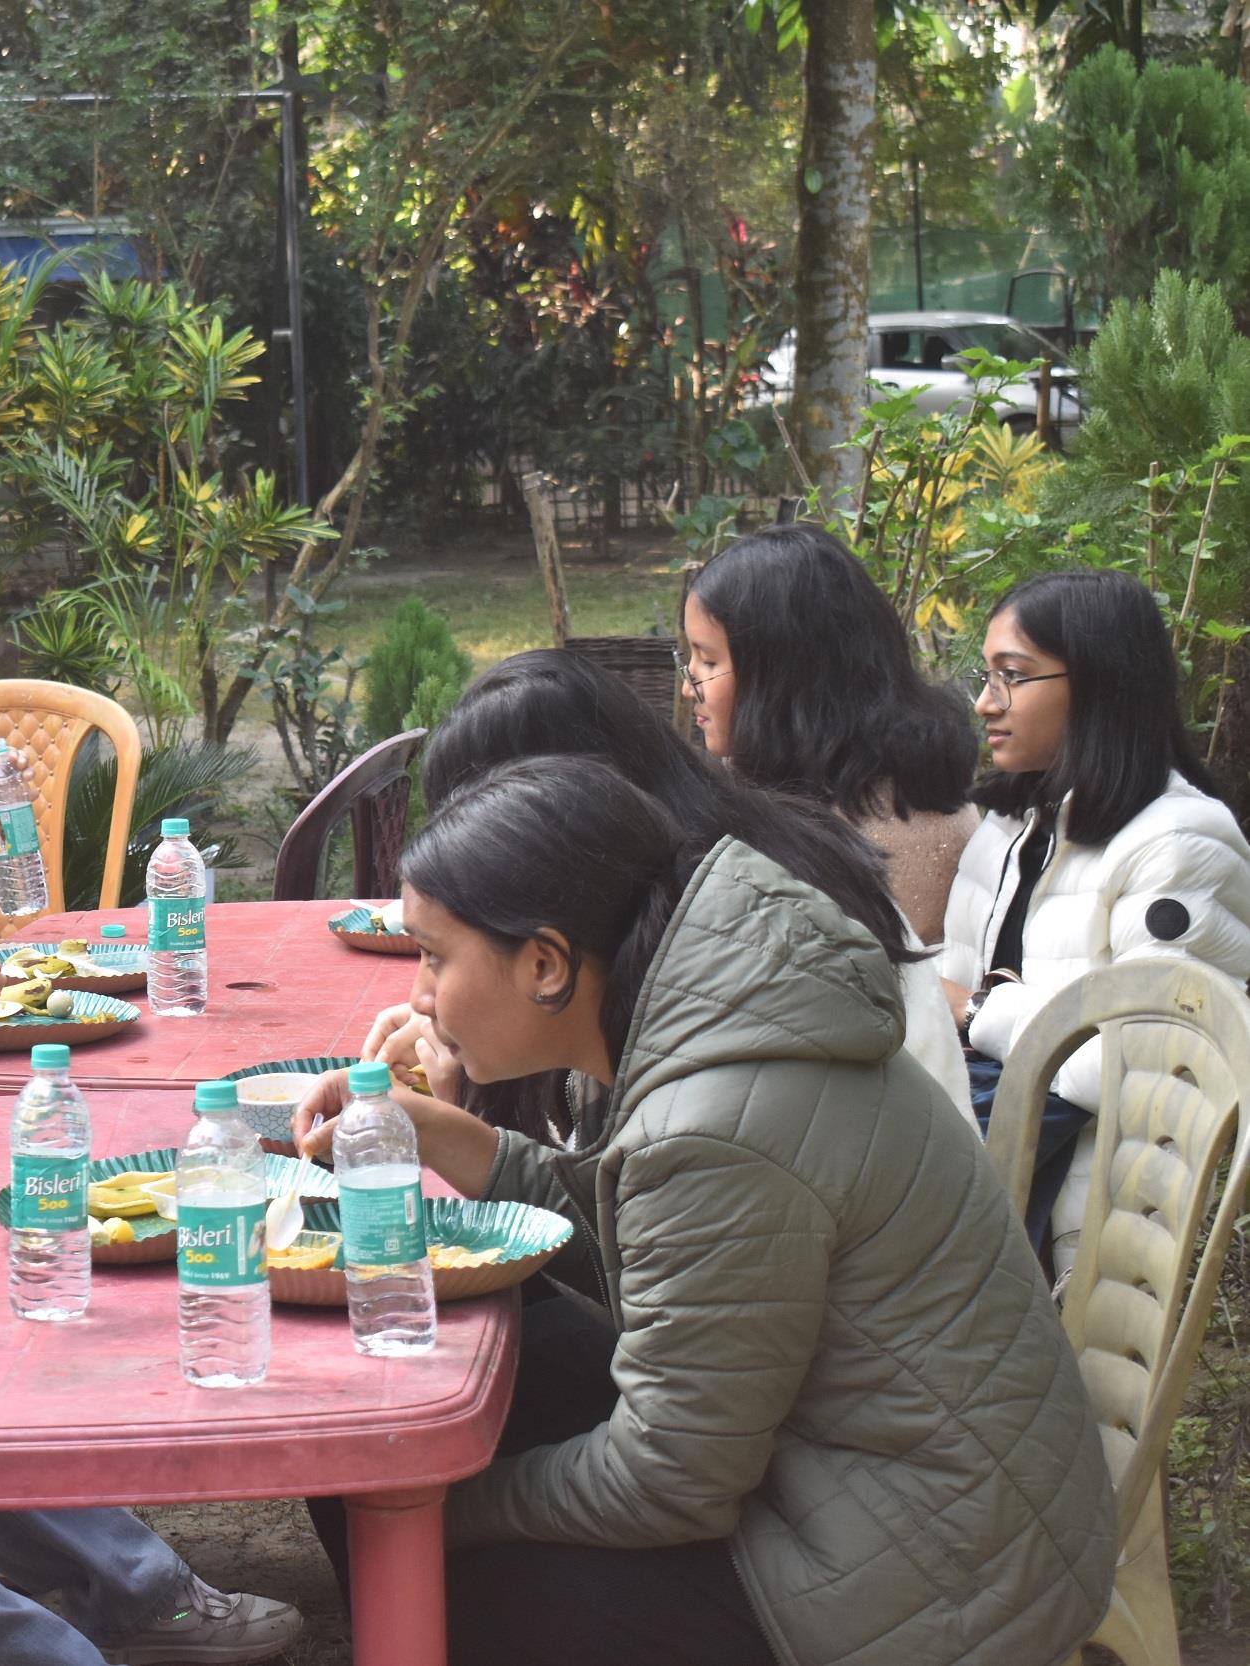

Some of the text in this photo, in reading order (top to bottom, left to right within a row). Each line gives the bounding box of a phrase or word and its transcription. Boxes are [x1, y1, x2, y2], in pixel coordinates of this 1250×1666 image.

[178, 927, 198, 937] 500
[25, 1171, 81, 1196] Bisleri
[38, 1198, 68, 1211] 500
[177, 1224, 231, 1247] Bisleri
[185, 1249, 214, 1264] 500
